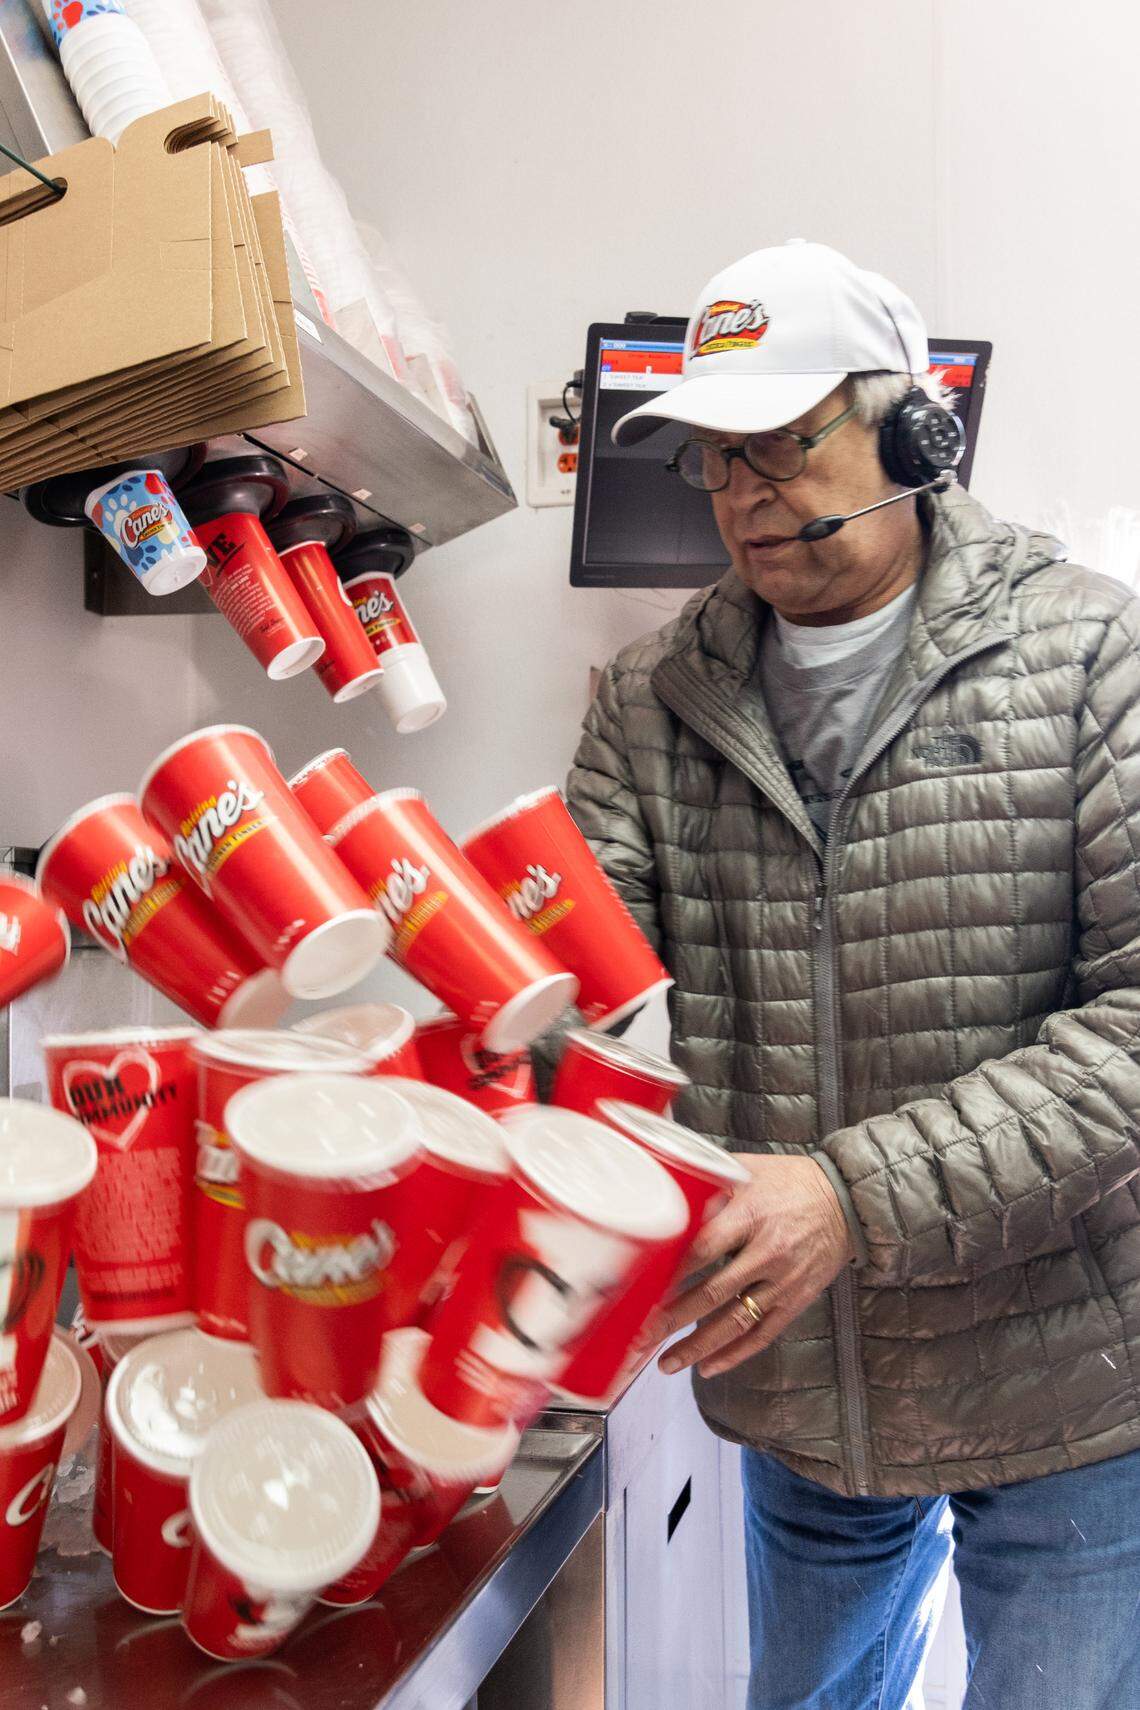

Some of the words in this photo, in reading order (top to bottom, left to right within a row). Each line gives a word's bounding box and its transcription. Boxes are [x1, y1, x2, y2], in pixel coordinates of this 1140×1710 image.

[120, 503, 168, 548] Cane's
[206, 532, 236, 566] VE
[356, 590, 394, 623] ne's
[173, 780, 265, 901] Cane's
[376, 859, 430, 924] ne's
[505, 864, 562, 921] ne's
